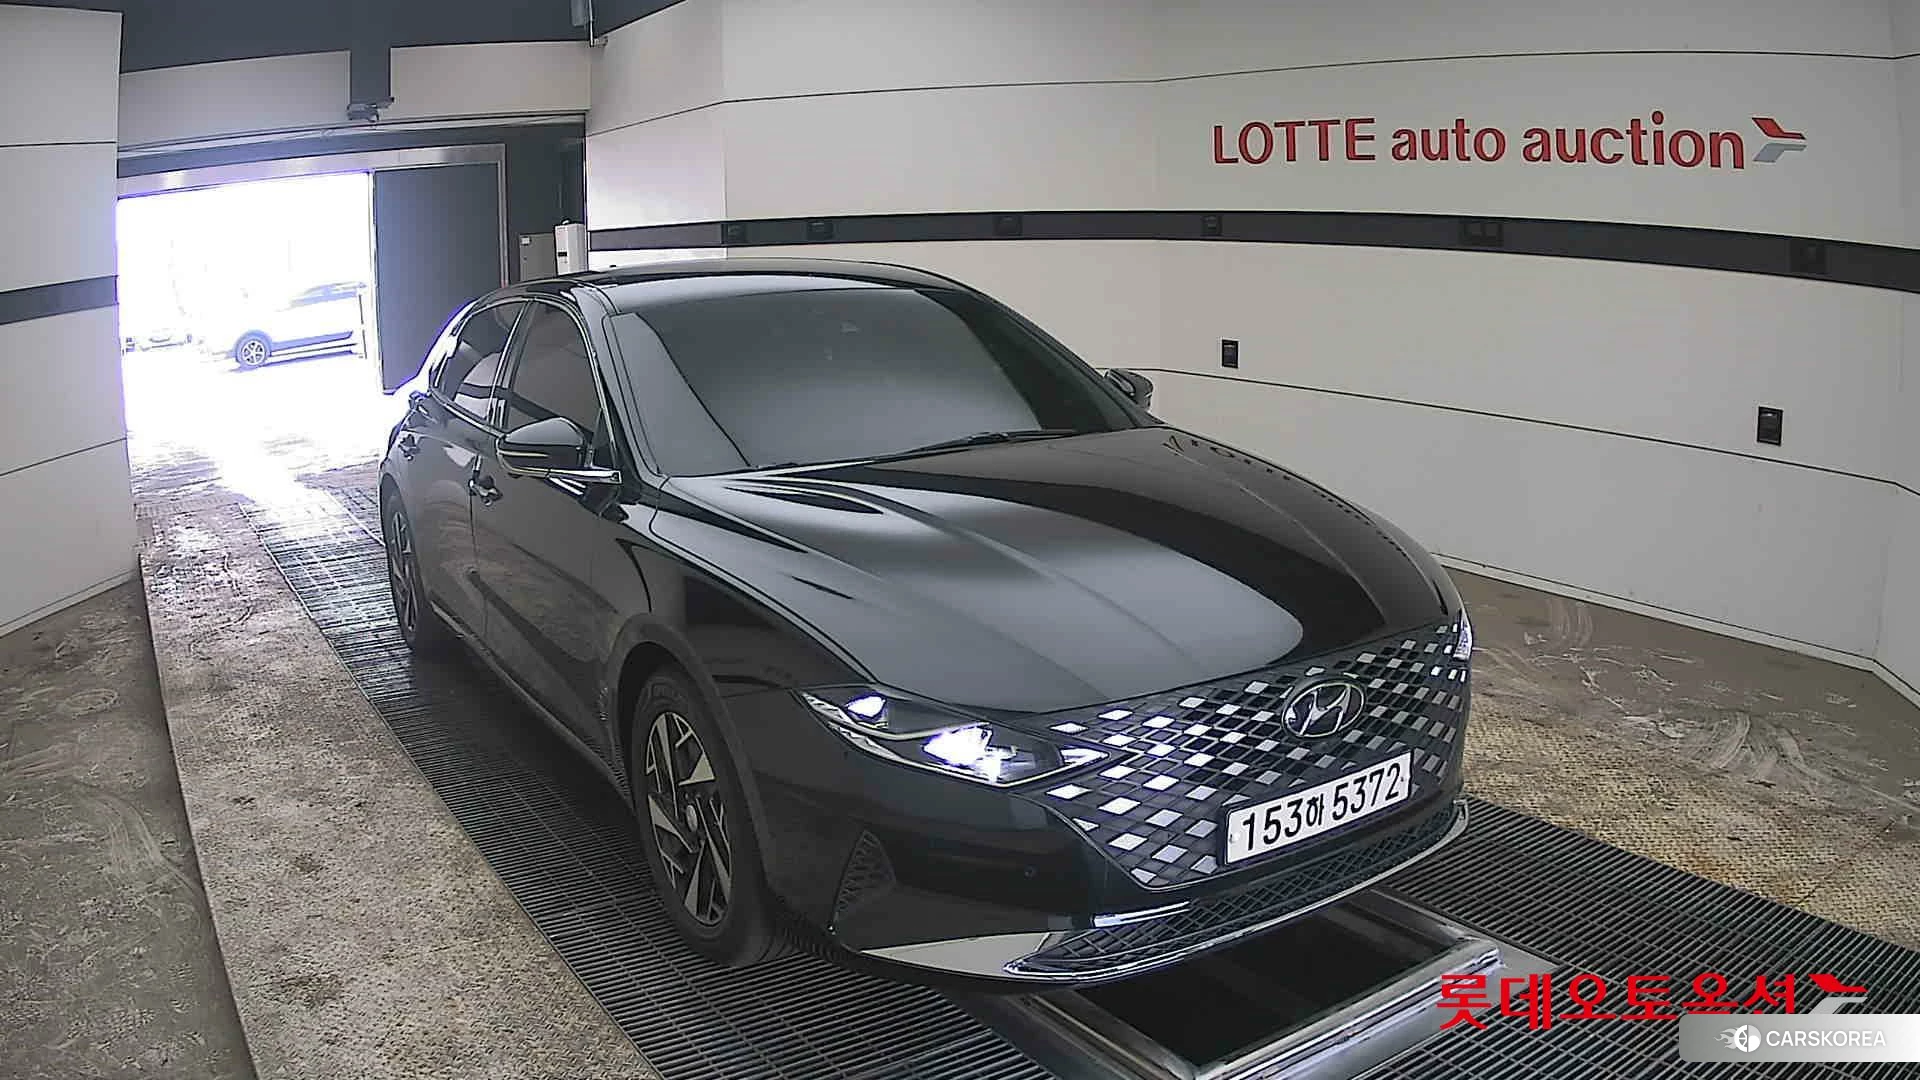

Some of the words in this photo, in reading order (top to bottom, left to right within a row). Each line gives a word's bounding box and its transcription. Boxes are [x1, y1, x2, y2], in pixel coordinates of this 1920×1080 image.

[1213, 118, 1376, 164] LOTTE
[1392, 118, 1507, 162] auto
[1523, 111, 1745, 169] auction
[1242, 792, 1325, 851] 153하
[1332, 762, 1401, 821] 5372
